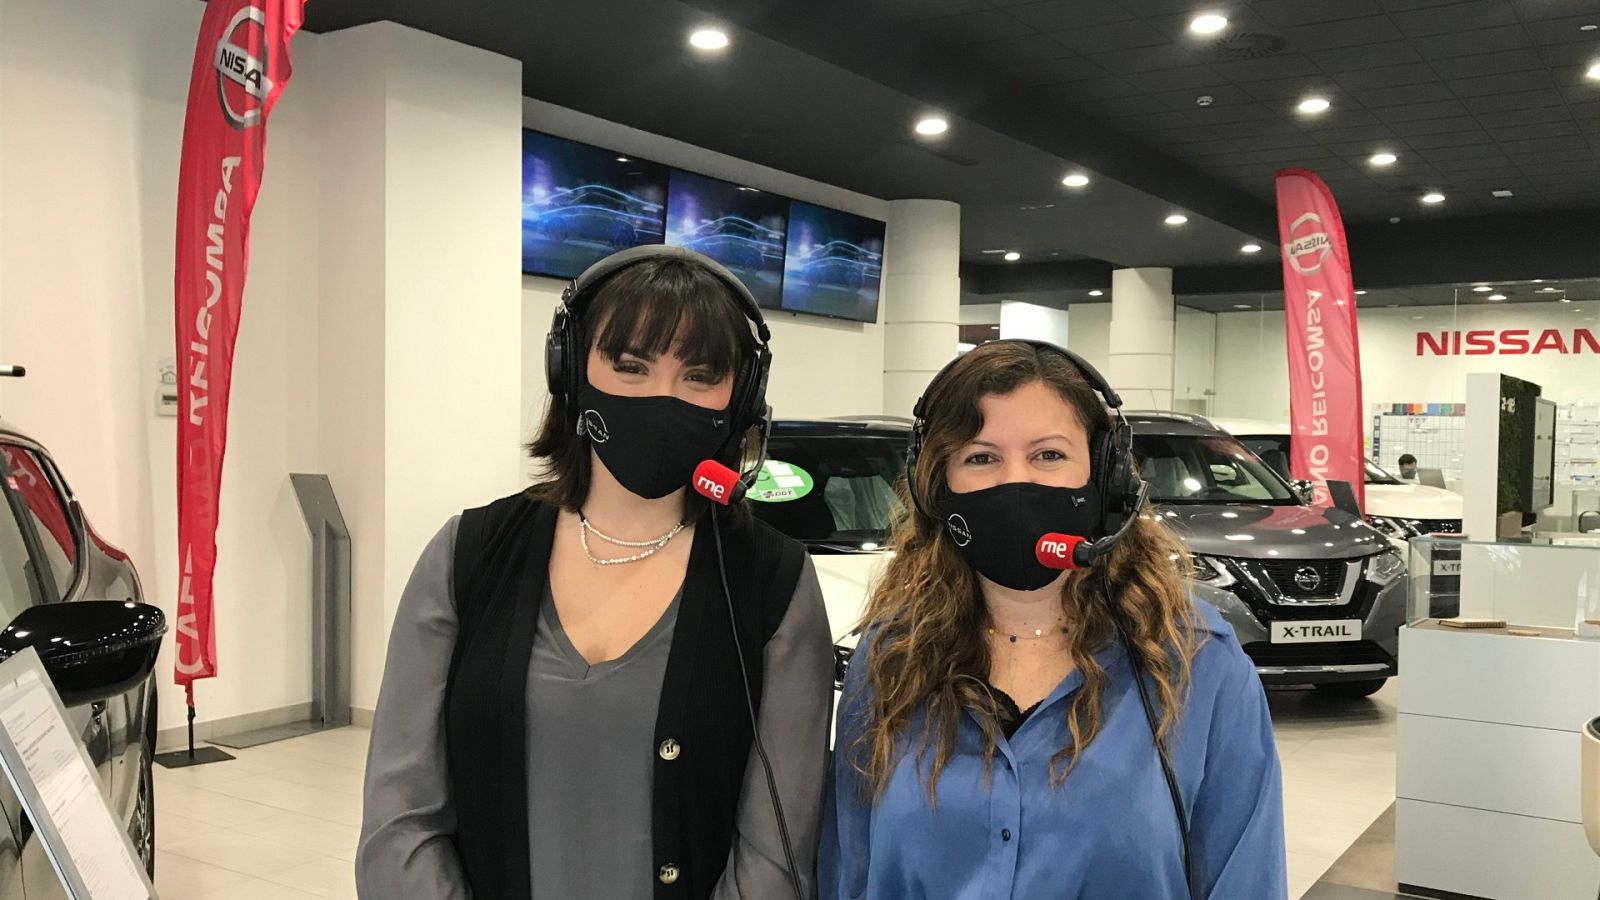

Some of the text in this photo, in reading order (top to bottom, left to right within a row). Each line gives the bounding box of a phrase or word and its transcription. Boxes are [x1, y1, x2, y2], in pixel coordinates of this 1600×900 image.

[1416, 328, 1600, 356] NISSAN
[697, 475, 725, 499] rne
[1040, 540, 1067, 559] rne
[1283, 624, 1352, 639] X-TRAIL
